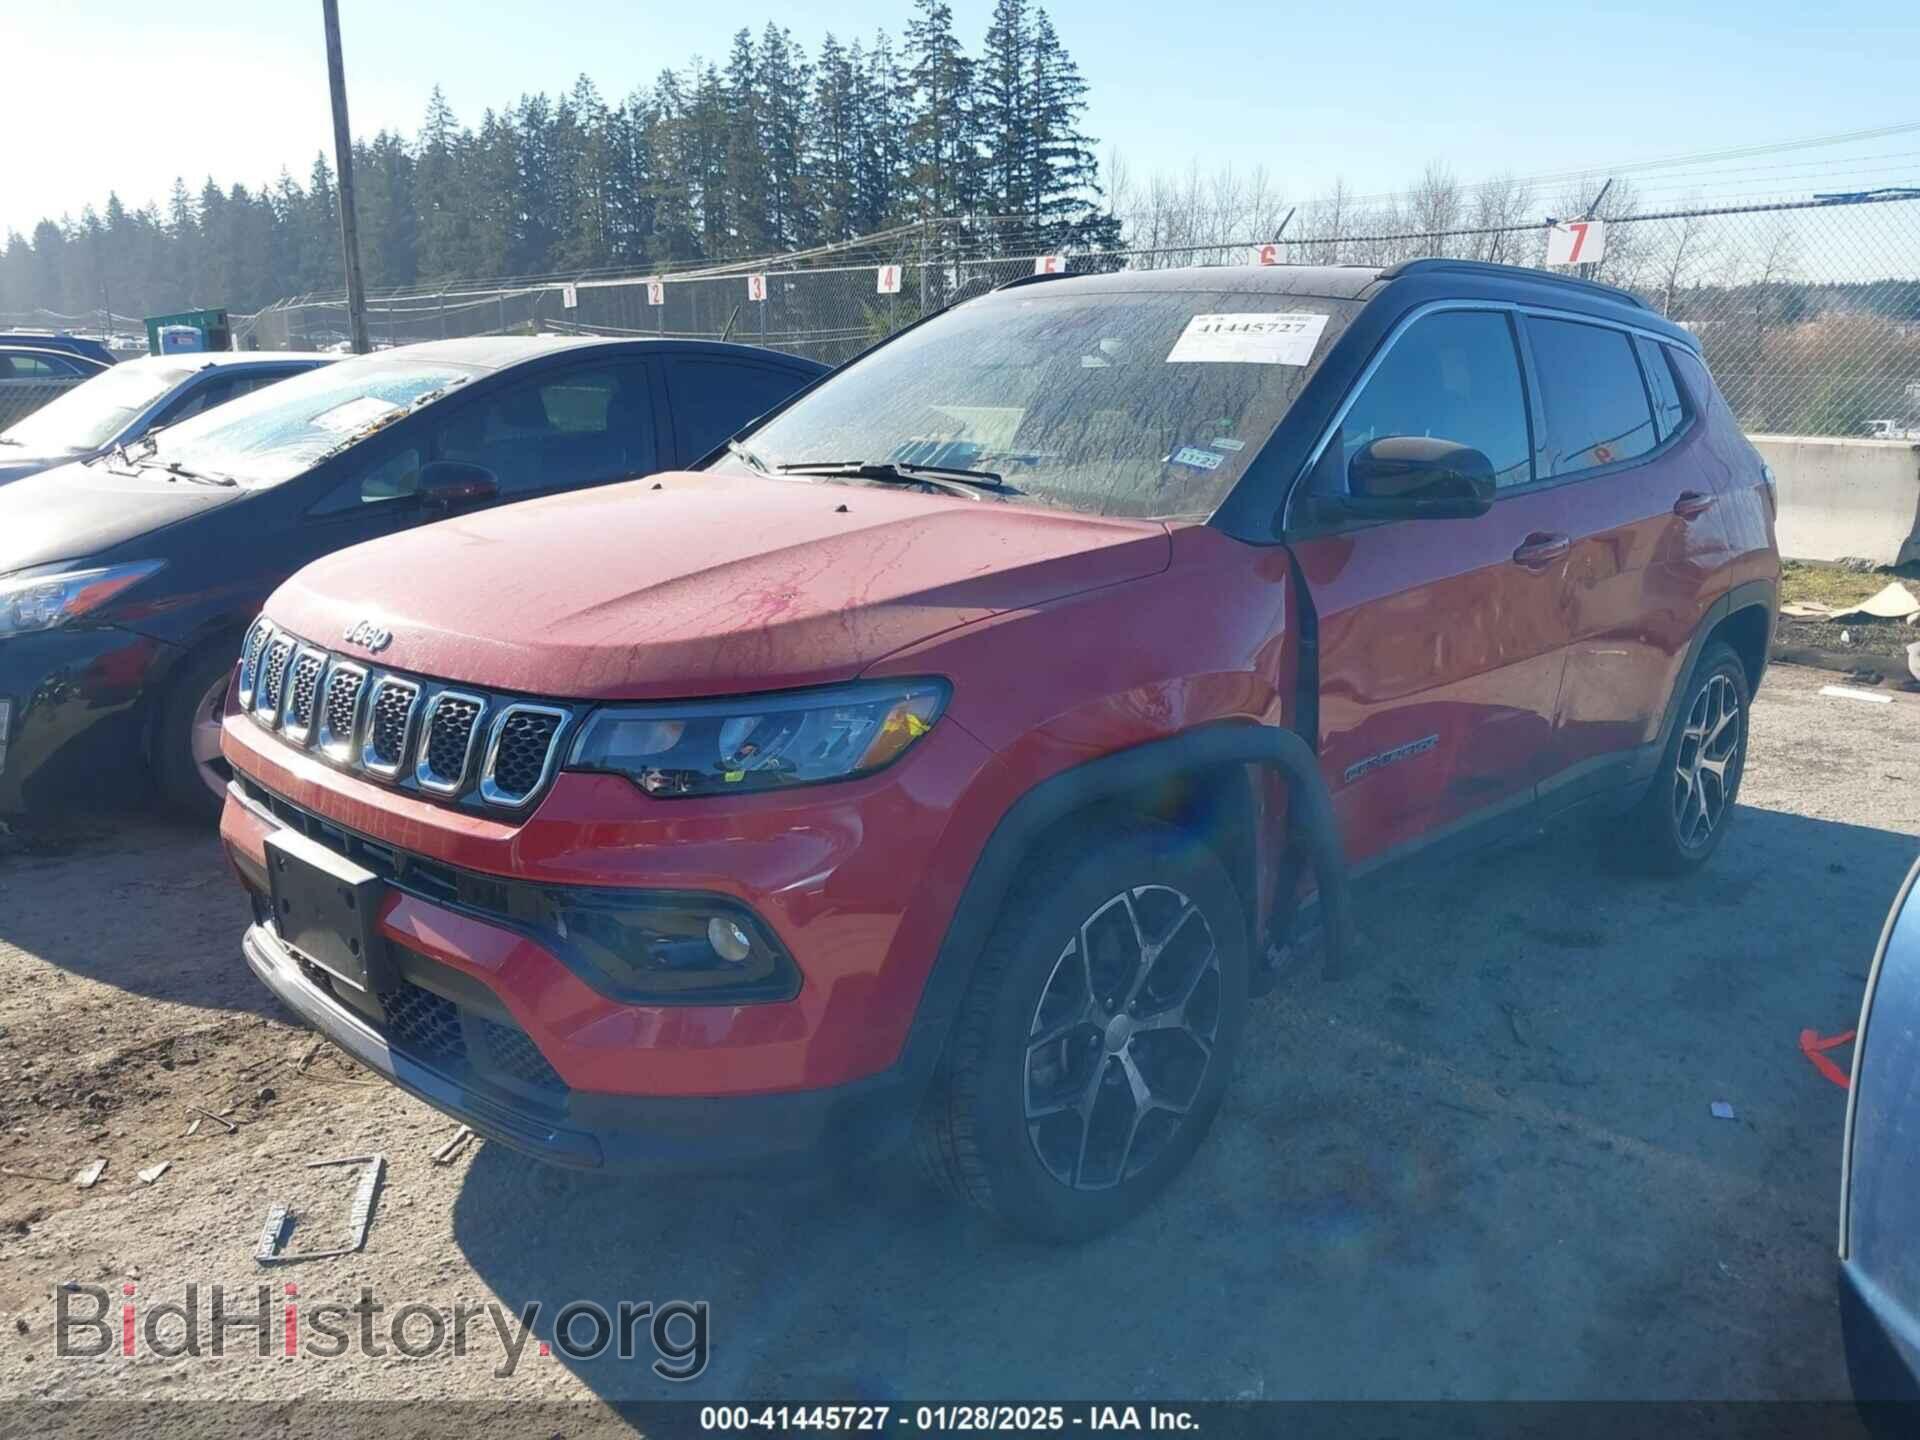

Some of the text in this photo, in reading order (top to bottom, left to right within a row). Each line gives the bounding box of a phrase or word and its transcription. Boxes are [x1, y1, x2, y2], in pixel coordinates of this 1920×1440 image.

[1569, 223, 1588, 262] 7
[753, 277, 762, 298] 3
[884, 266, 894, 291] 4
[652, 284, 660, 304] 2
[1198, 322, 1307, 334] 41445727
[344, 618, 393, 655] Jeep
